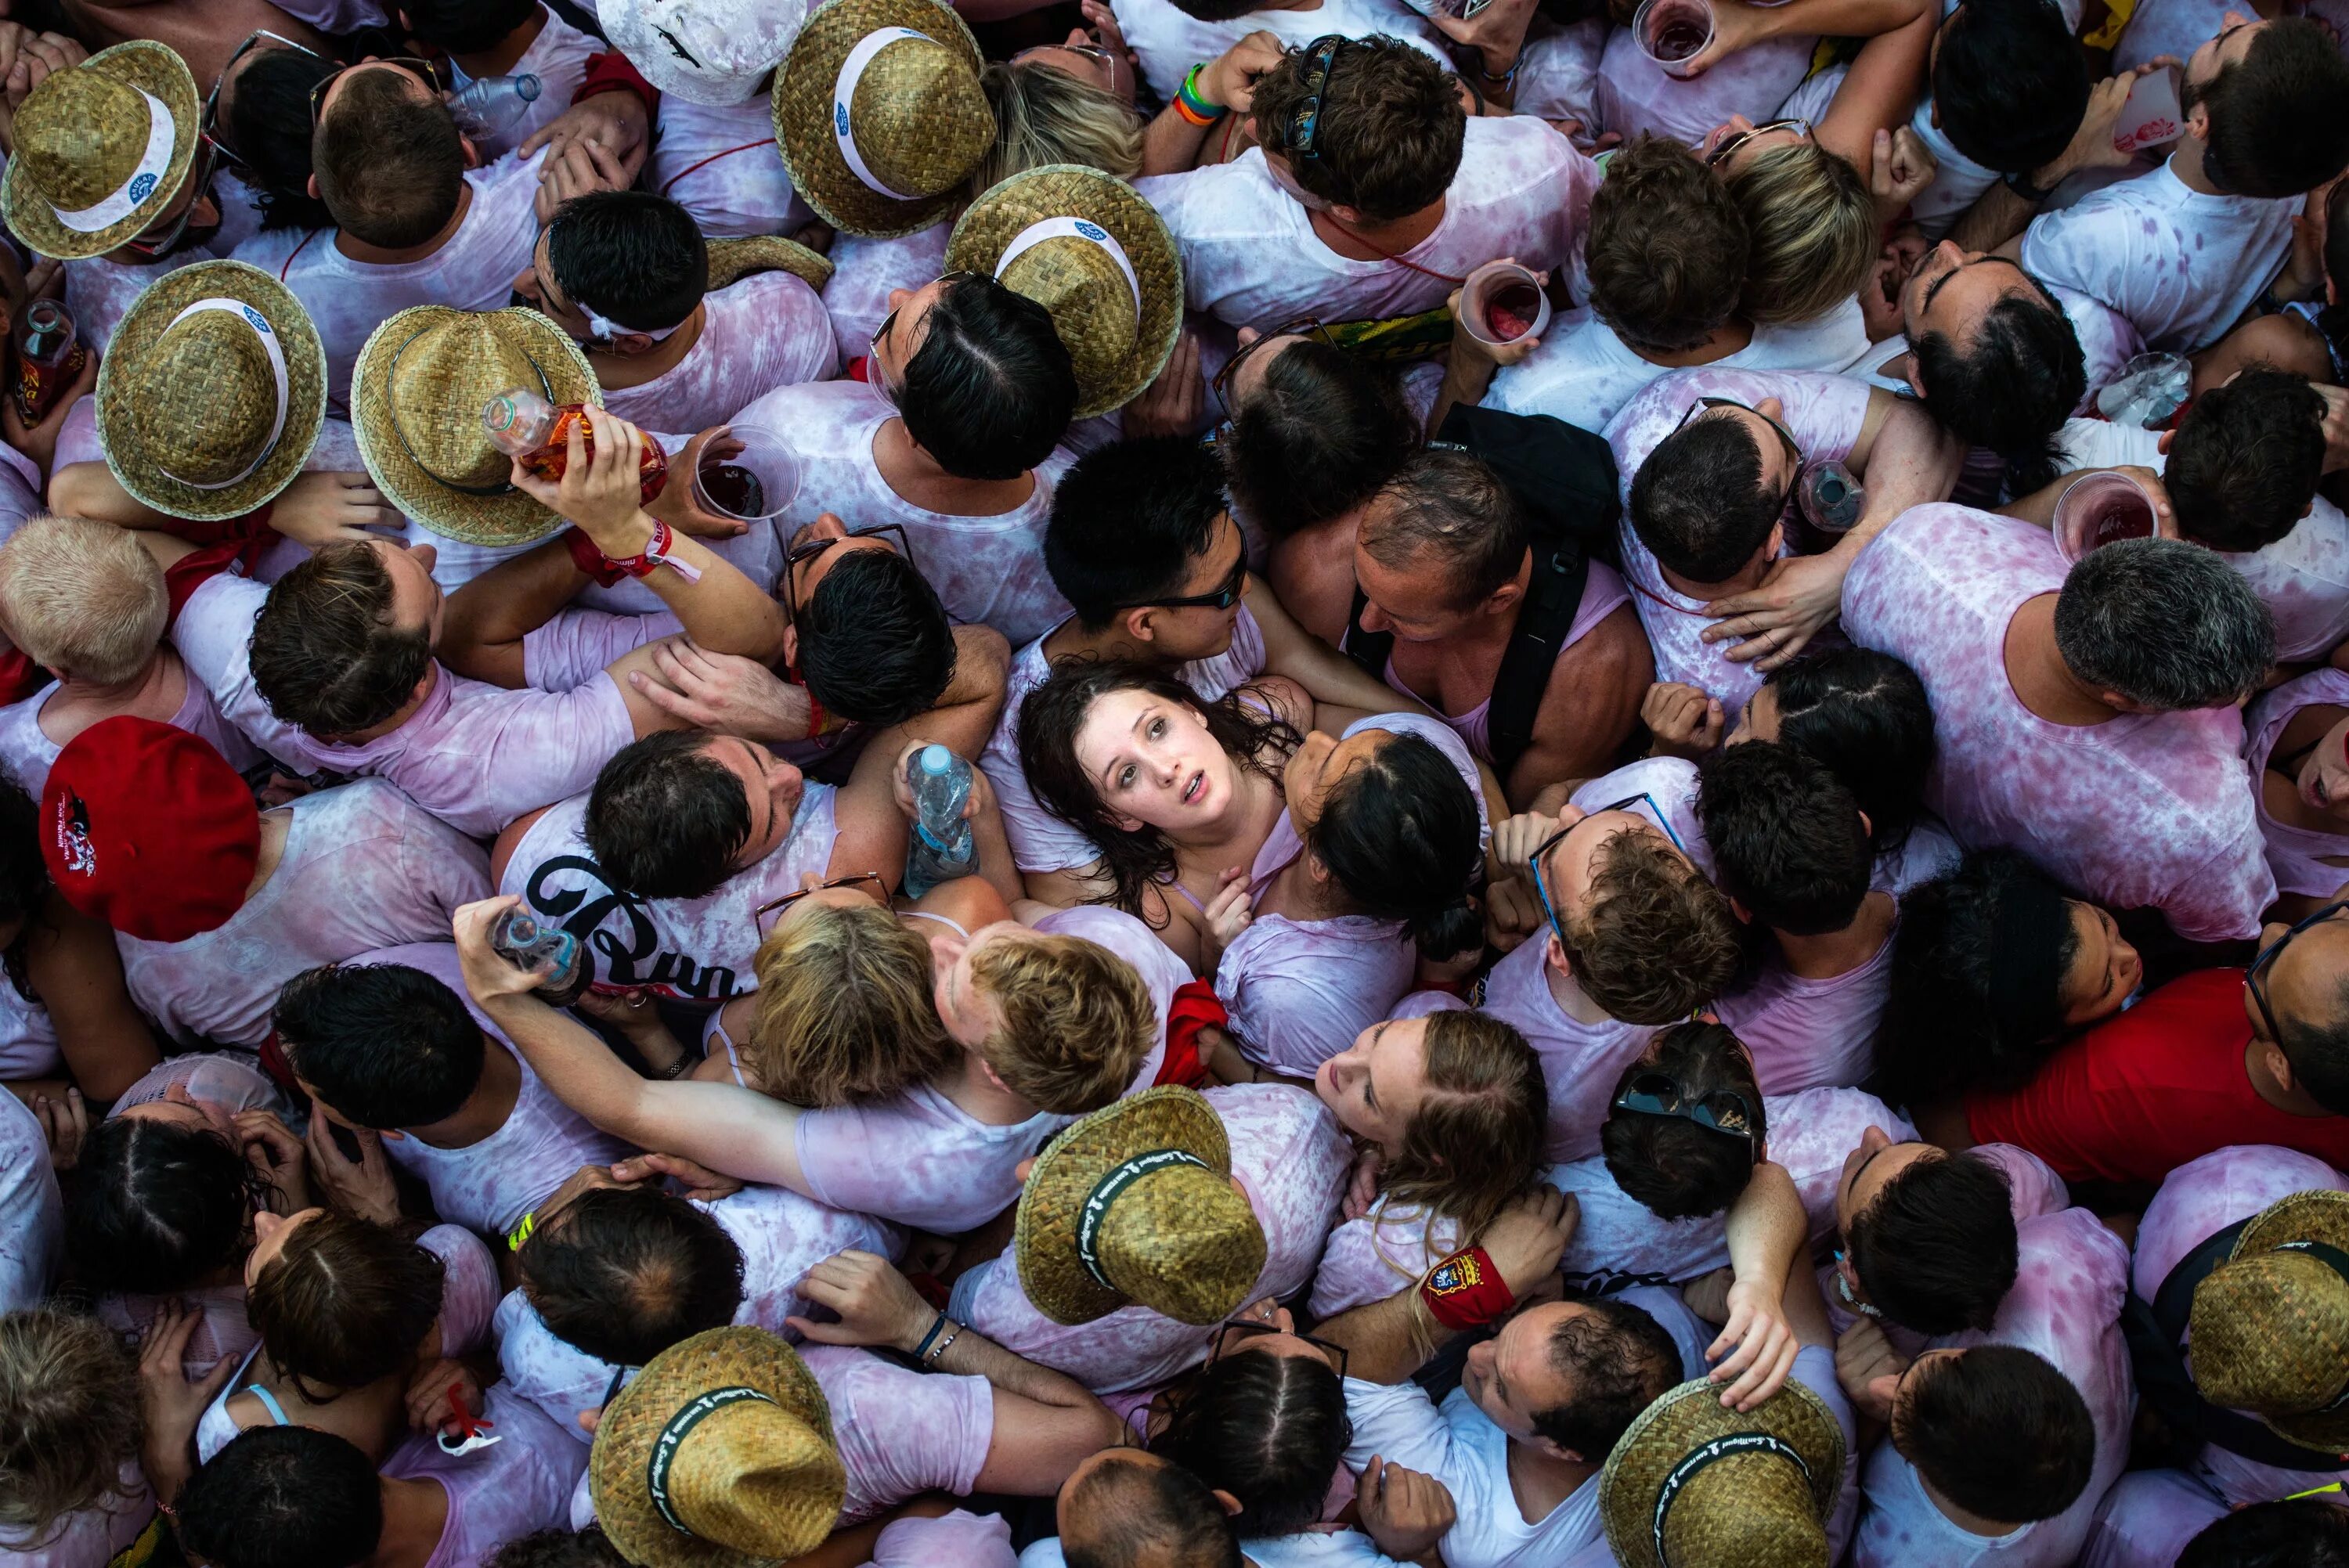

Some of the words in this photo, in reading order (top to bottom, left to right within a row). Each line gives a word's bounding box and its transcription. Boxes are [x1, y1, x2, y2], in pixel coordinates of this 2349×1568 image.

[132, 175, 153, 198] BRUGAL
[1077, 224, 1103, 239] BRUGAL
[246, 308, 266, 330] BRUGAL
[1116, 1170, 1128, 1183] SAN
[690, 1405, 703, 1416] SAN
[1696, 1450, 1709, 1461] SAN
